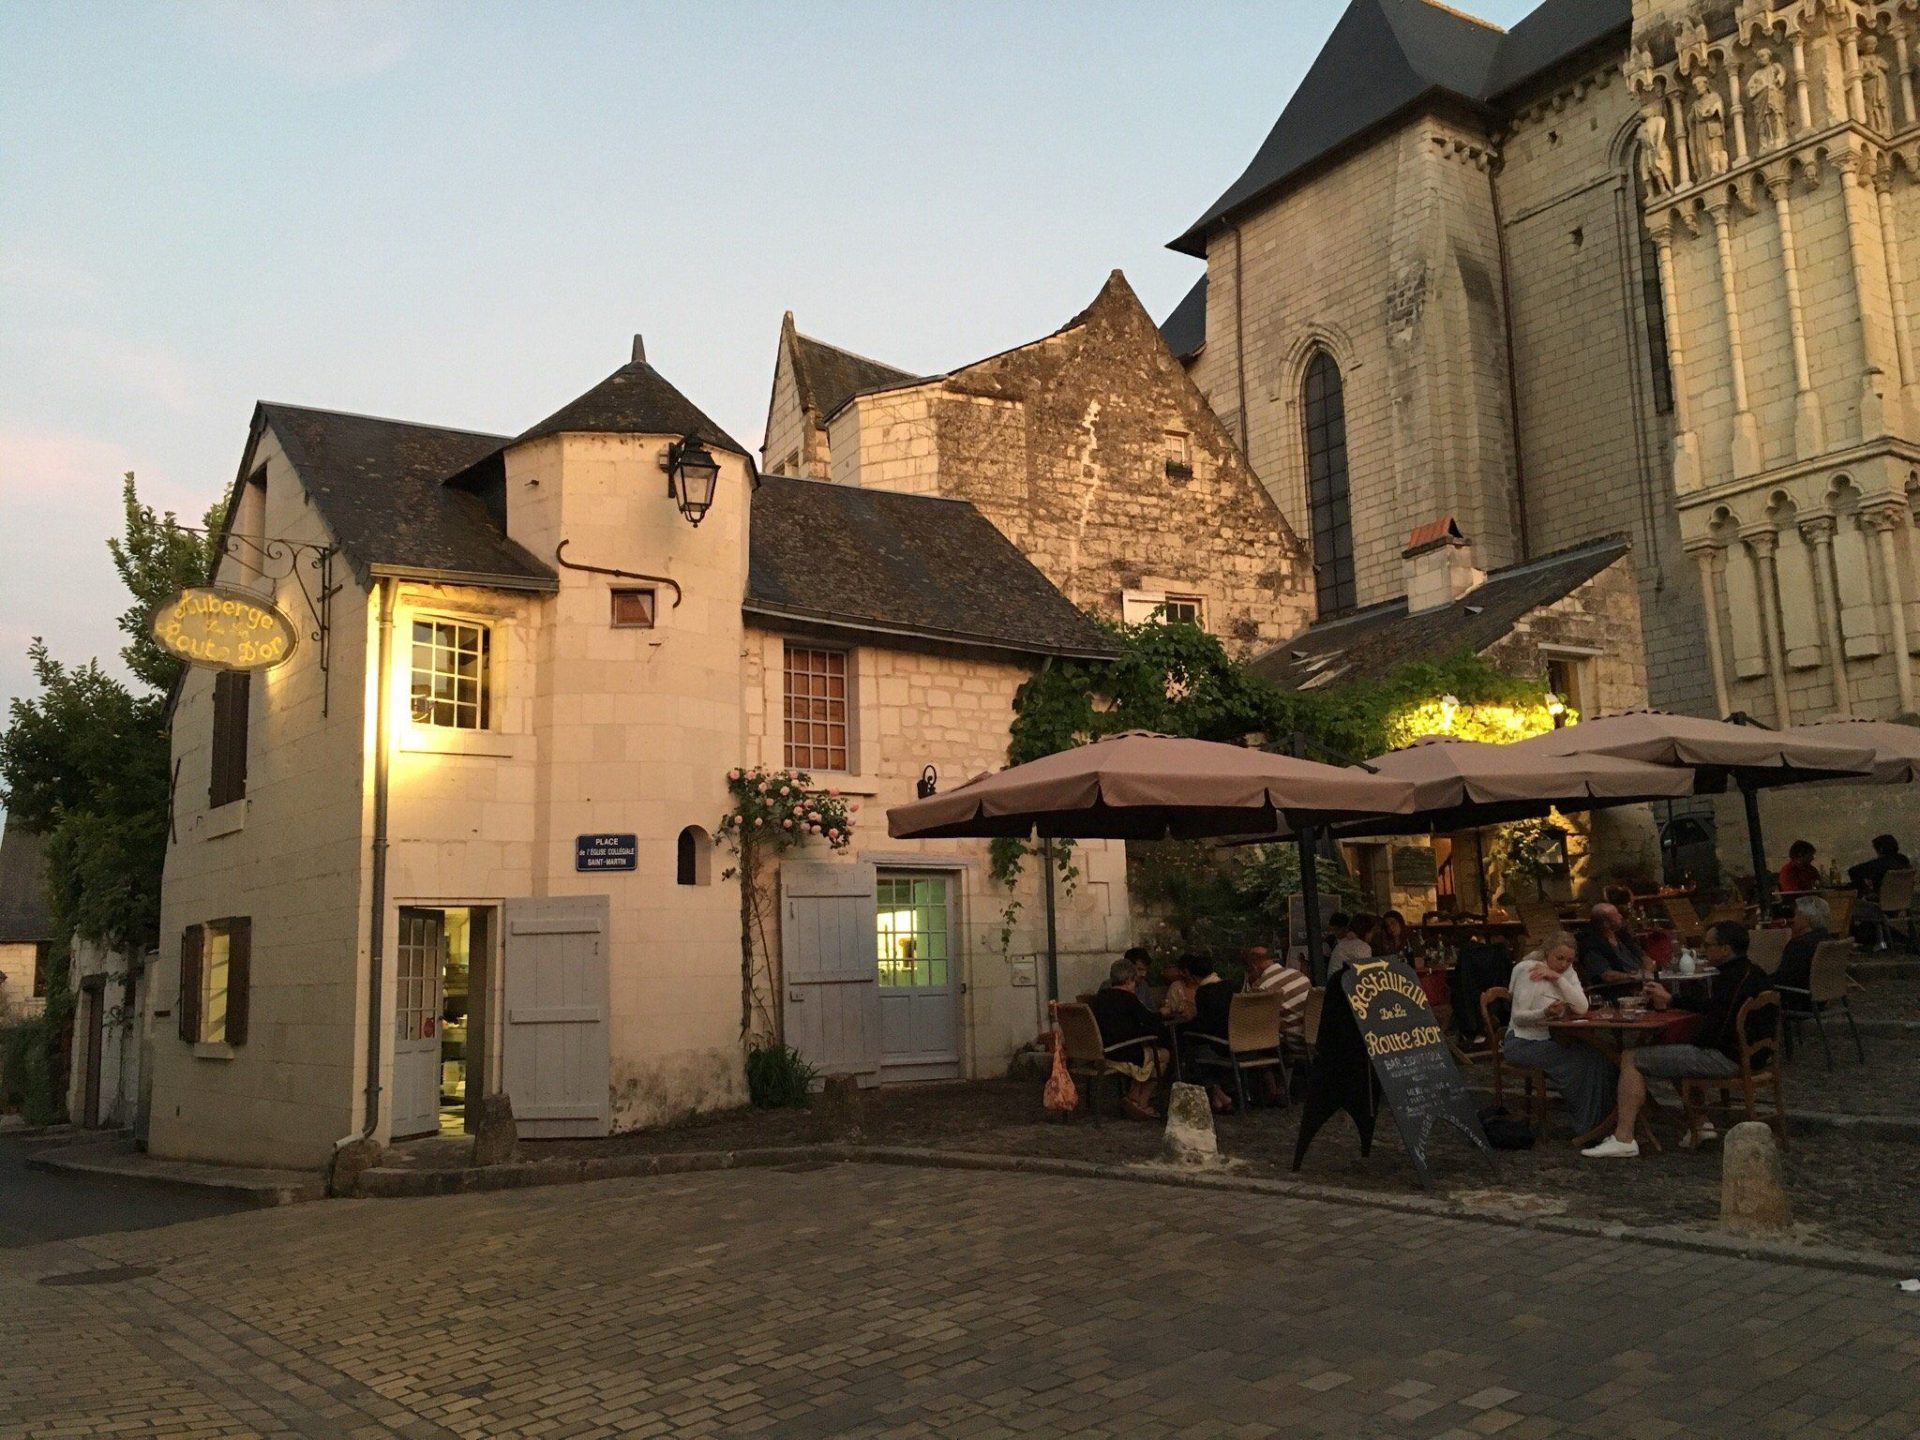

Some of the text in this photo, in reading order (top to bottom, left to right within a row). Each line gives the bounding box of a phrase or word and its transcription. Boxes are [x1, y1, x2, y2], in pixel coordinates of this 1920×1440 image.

[595, 838, 619, 846] PLACE
[587, 858, 627, 866] SAINT-MARTIN
[1347, 970, 1428, 1020] Restaurant
[1379, 1007, 1394, 1020] De
[1364, 1030, 1413, 1057] Route
